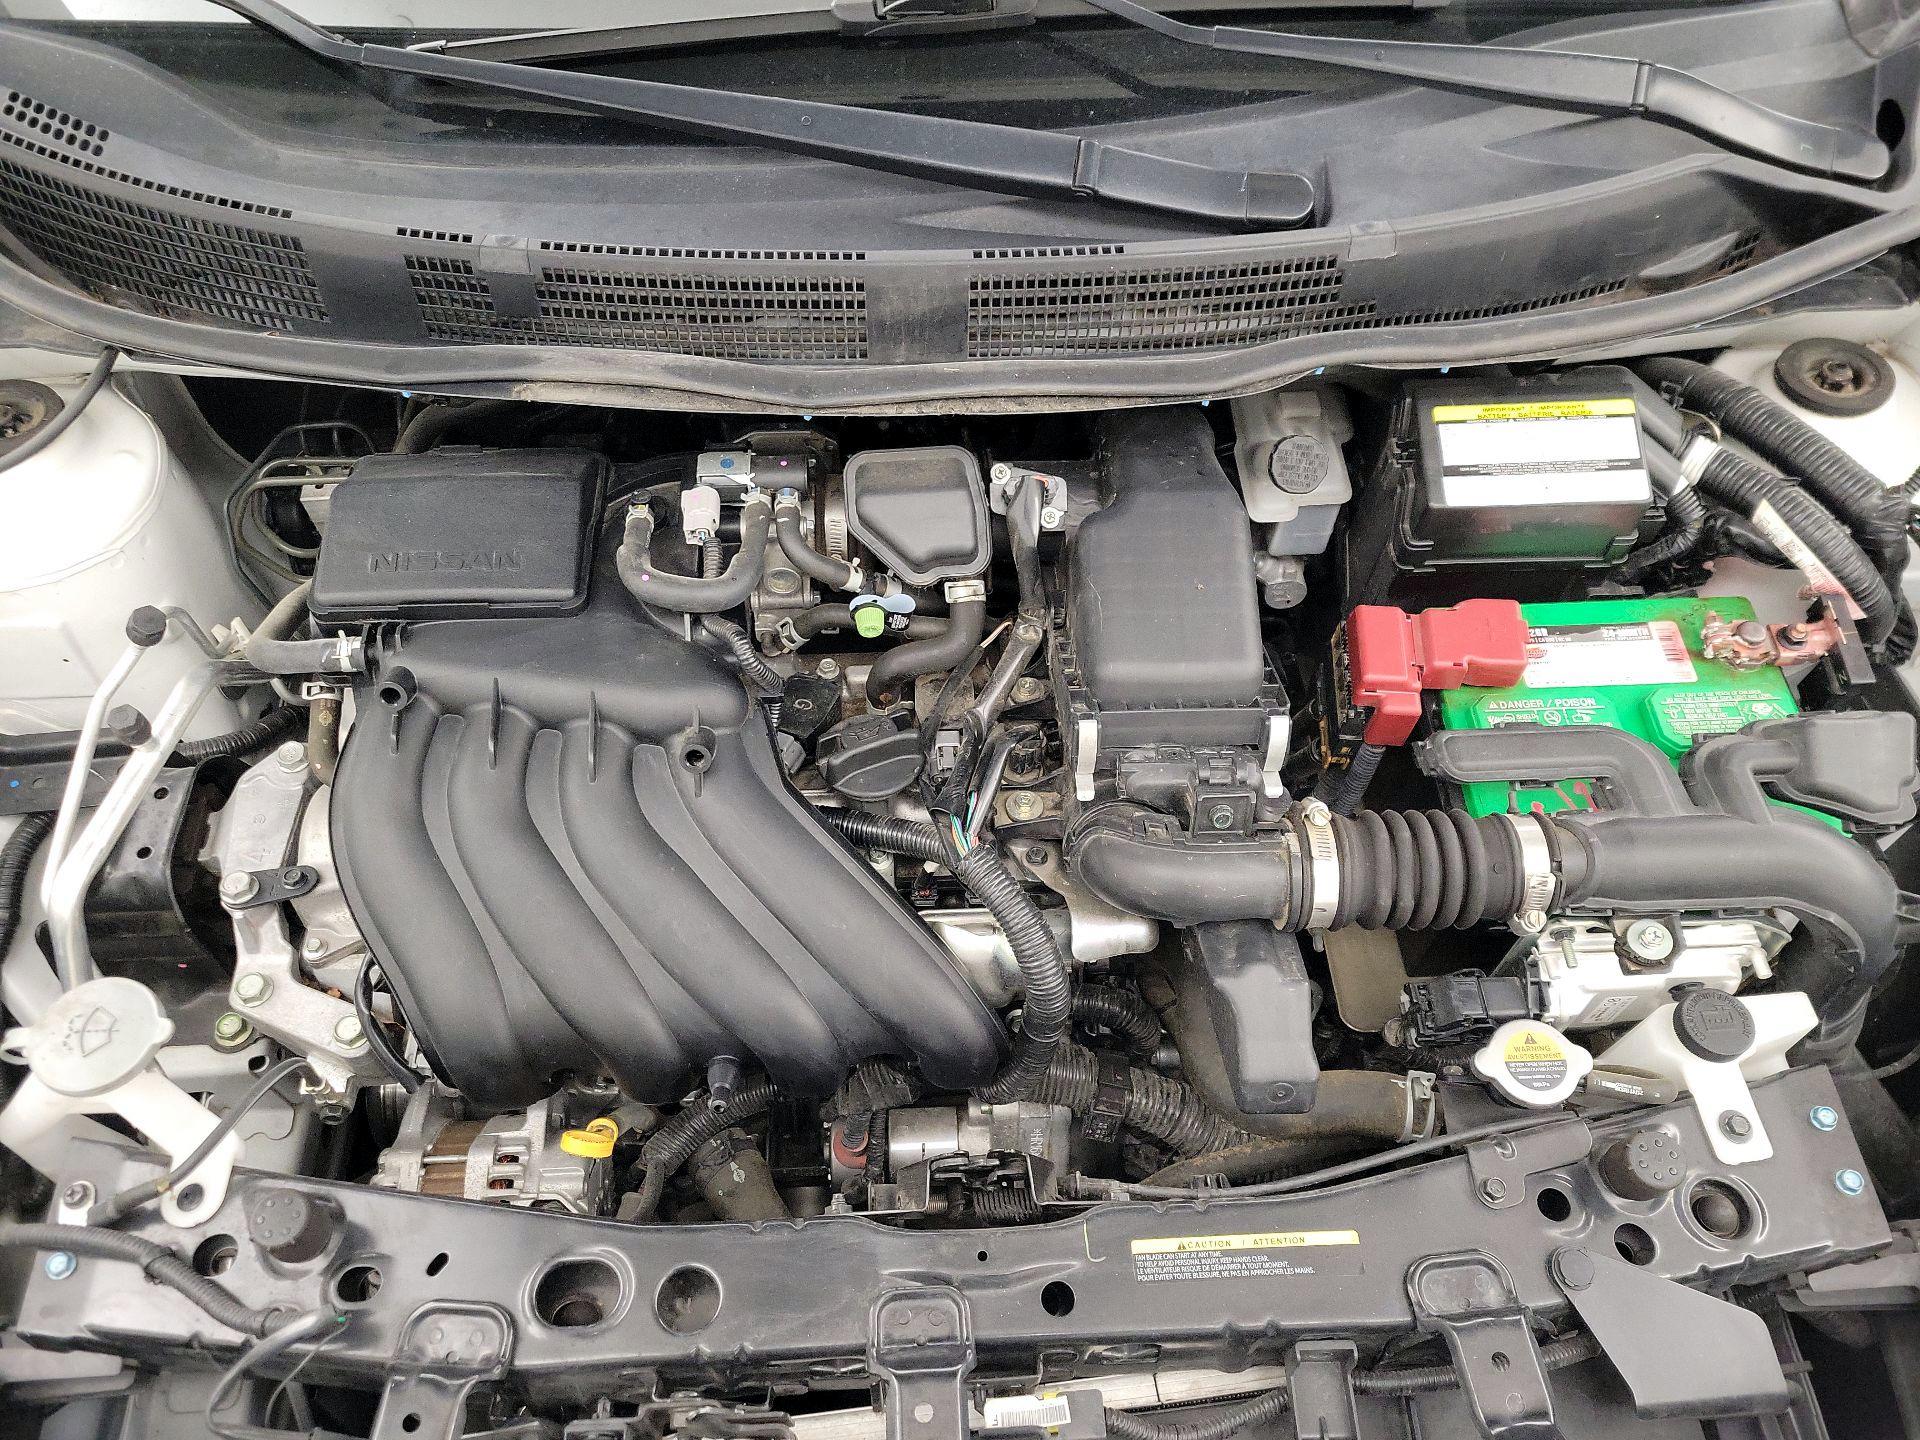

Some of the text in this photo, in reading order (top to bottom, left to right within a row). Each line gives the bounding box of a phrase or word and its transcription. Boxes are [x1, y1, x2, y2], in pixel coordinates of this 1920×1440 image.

[369, 549, 527, 574] NISSAN
[1500, 699, 1544, 709] DANGER
[1554, 697, 1597, 707] POISON
[1507, 1052, 1561, 1060] AVERTISSEMENT
[1187, 1240, 1231, 1249] CAUTION
[1253, 1237, 1305, 1246] ATTENTION
[1163, 1252, 1174, 1260] CAN
[1144, 1260, 1157, 1268] HELP
[1158, 1259, 1174, 1267] AVOID
[1174, 1258, 1201, 1266] PERSONAL
[1137, 1274, 1154, 1282] POUR
[1174, 1272, 1192, 1280] TOUTE
[1222, 1270, 1230, 1278] NE
[1250, 1268, 1284, 1276] APPROCHER
[1284, 1267, 1294, 1275] LES
[1144, 1266, 1181, 1274] VENTILATEUR
[1181, 1265, 1202, 1273] RISQUE
